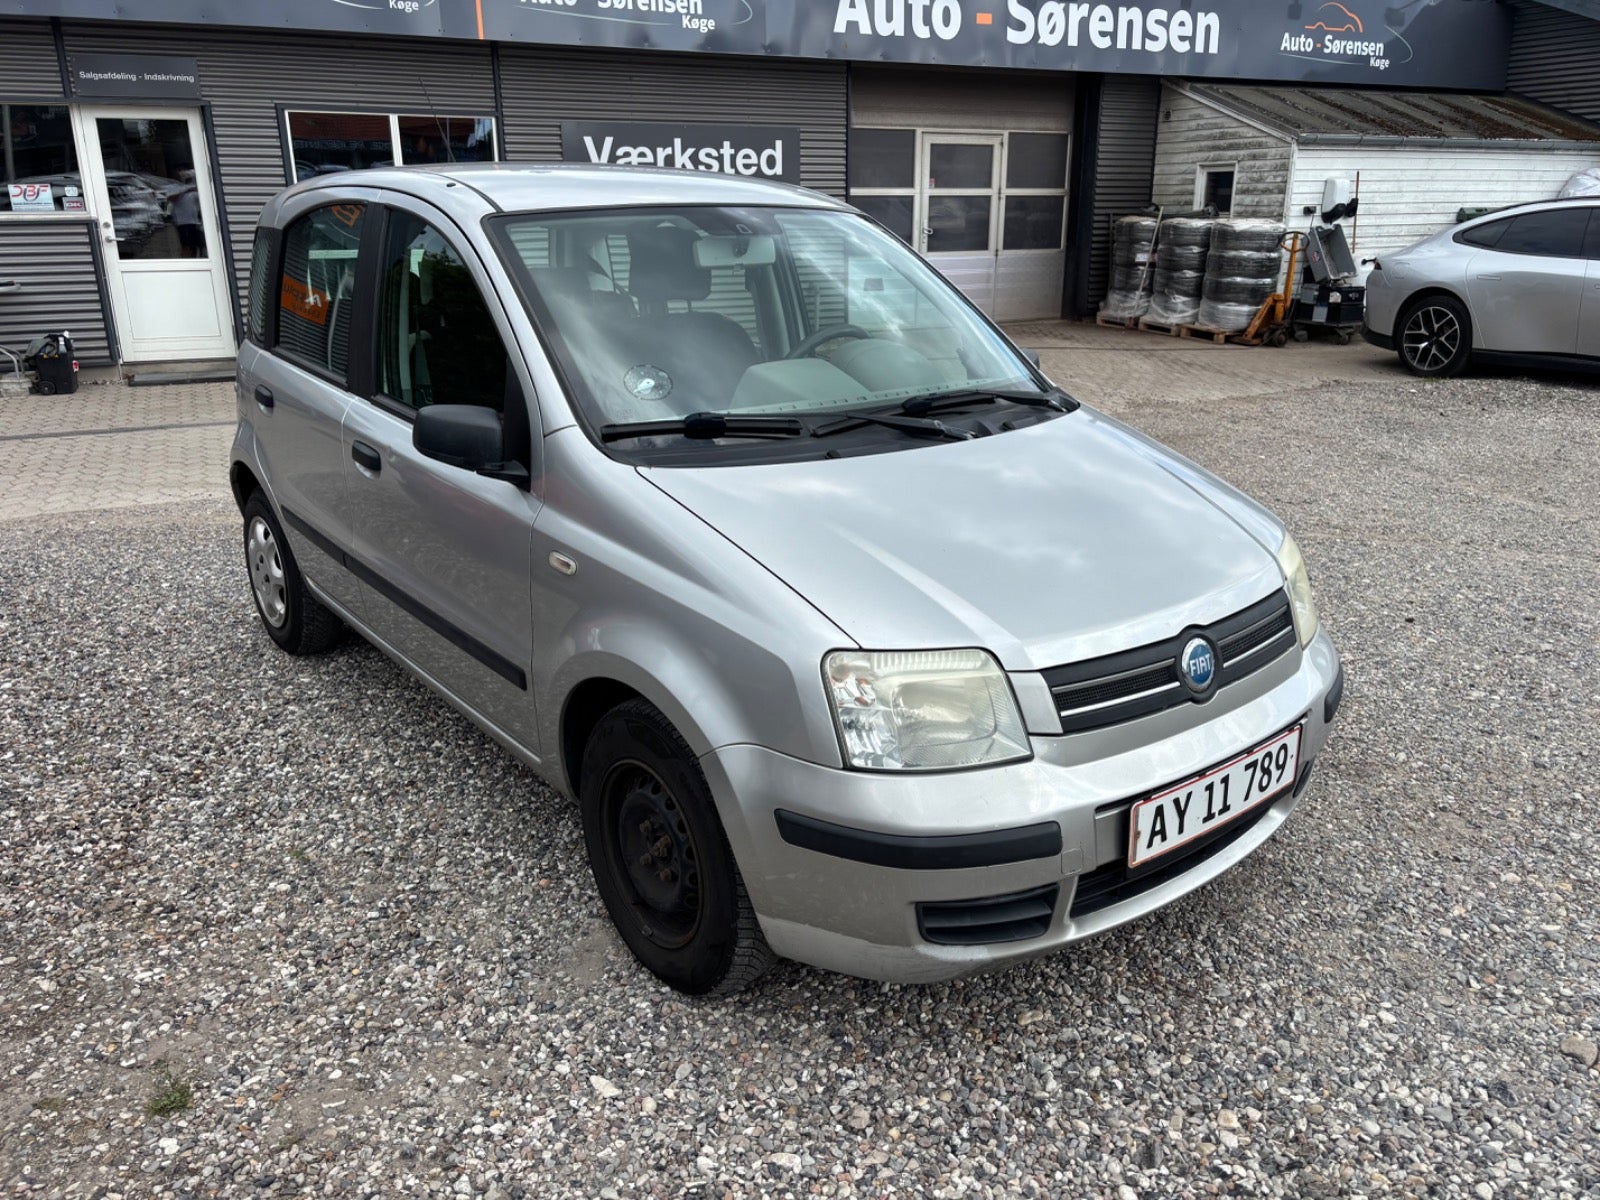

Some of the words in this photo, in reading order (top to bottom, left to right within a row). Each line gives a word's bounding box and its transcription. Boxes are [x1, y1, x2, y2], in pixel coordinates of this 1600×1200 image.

[389, 0, 419, 13] Køge
[682, 15, 715, 33] Køge
[833, 0, 962, 40] Auto
[1006, 0, 1220, 54] Sørensen
[1280, 32, 1313, 52] Auto
[1323, 34, 1384, 56] Sørensen
[1369, 57, 1390, 70] Køge
[79, 71, 137, 81] Salgsafdeling
[144, 73, 195, 83] Indskrivning
[583, 136, 783, 176] Værksted
[1189, 653, 1211, 677] FIAT
[1146, 791, 1193, 849] AY
[1202, 773, 1231, 824] 11
[1244, 743, 1288, 802] 789
